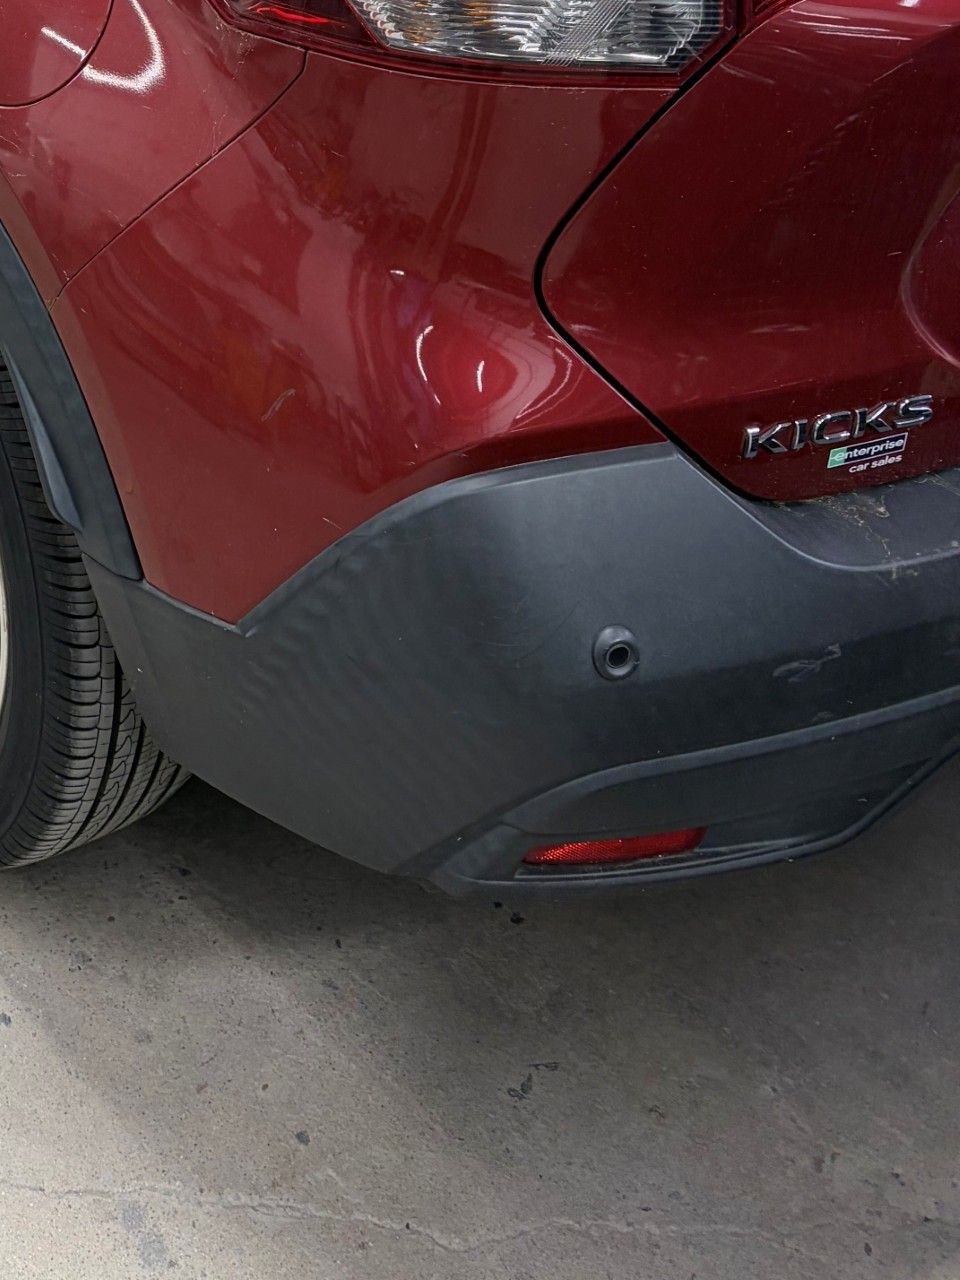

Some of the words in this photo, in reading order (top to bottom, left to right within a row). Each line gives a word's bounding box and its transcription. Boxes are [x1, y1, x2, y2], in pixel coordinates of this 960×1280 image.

[743, 394, 933, 458] KICKS
[832, 437, 904, 462] enterprise
[849, 461, 870, 473] car
[871, 453, 902, 468] sales
